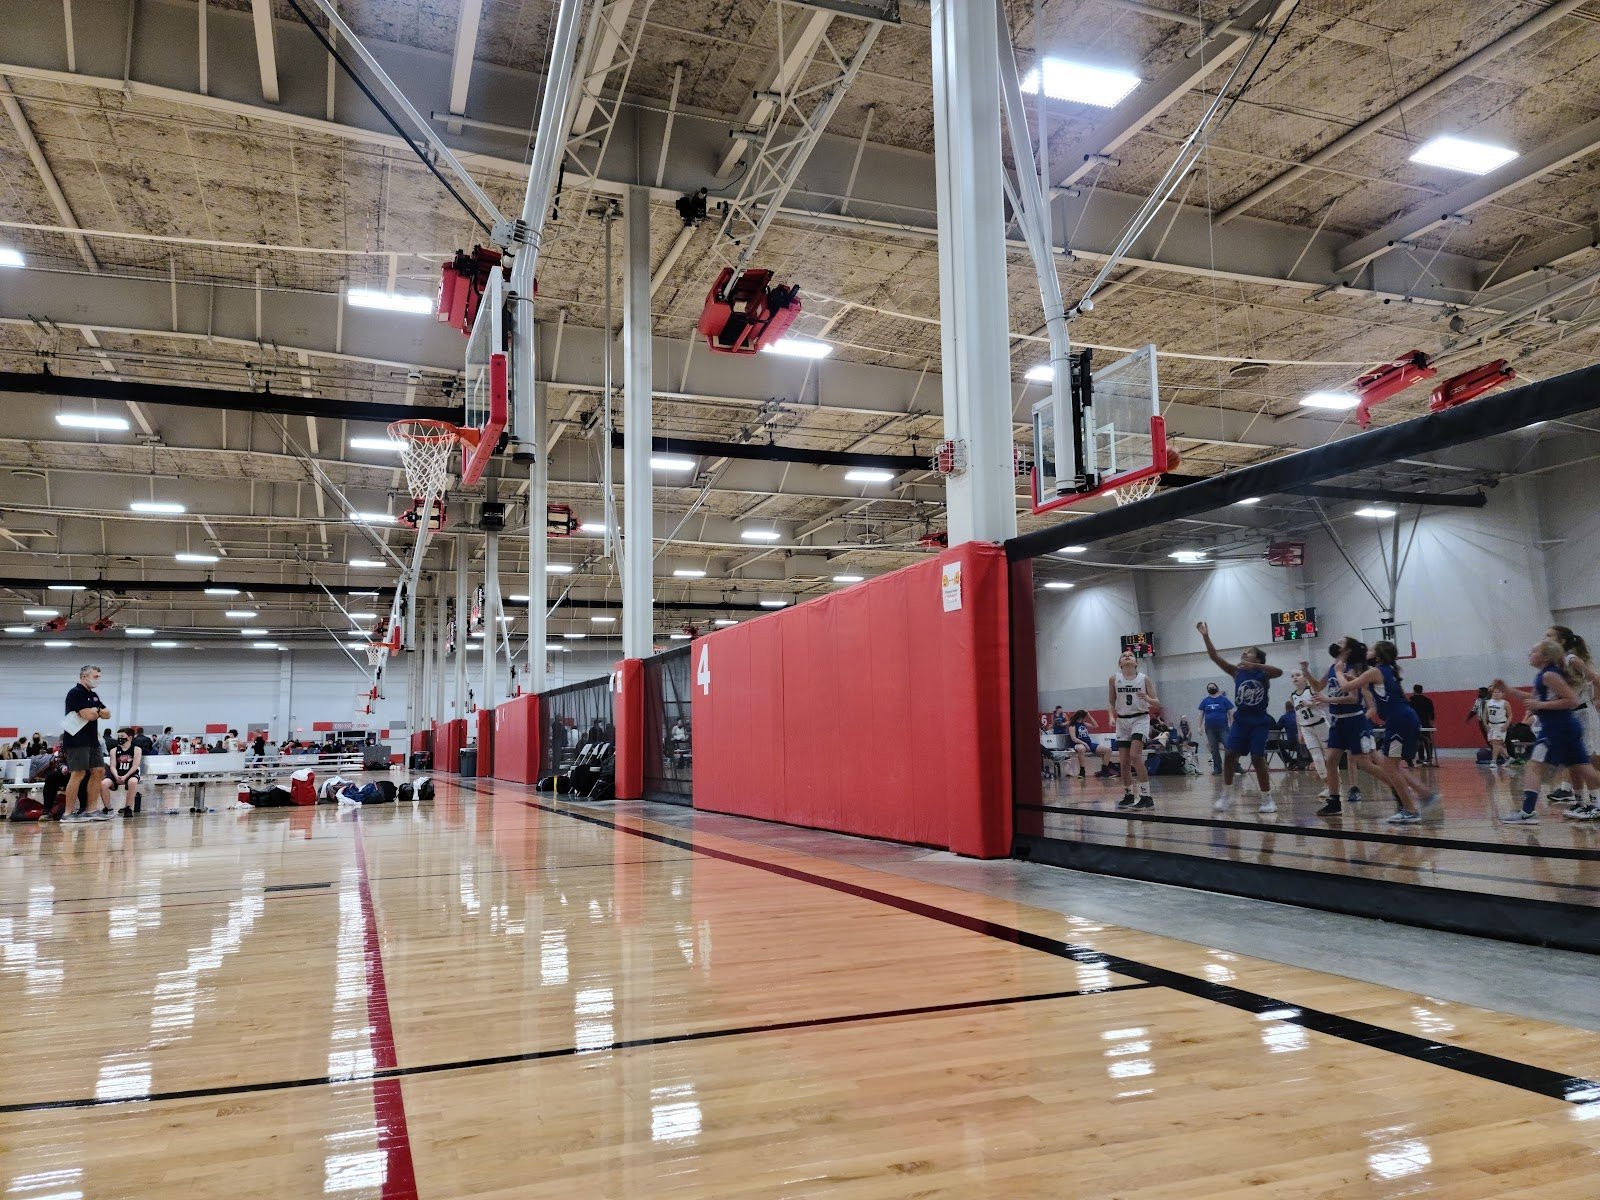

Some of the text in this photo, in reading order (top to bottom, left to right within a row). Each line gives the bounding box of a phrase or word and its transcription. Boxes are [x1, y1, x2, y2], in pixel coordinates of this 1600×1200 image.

[1291, 632, 1296, 640] 2
[697, 644, 711, 696] 4
[1302, 708, 1314, 720] 31
[1041, 714, 1048, 727] 6
[119, 762, 130, 770] 10
